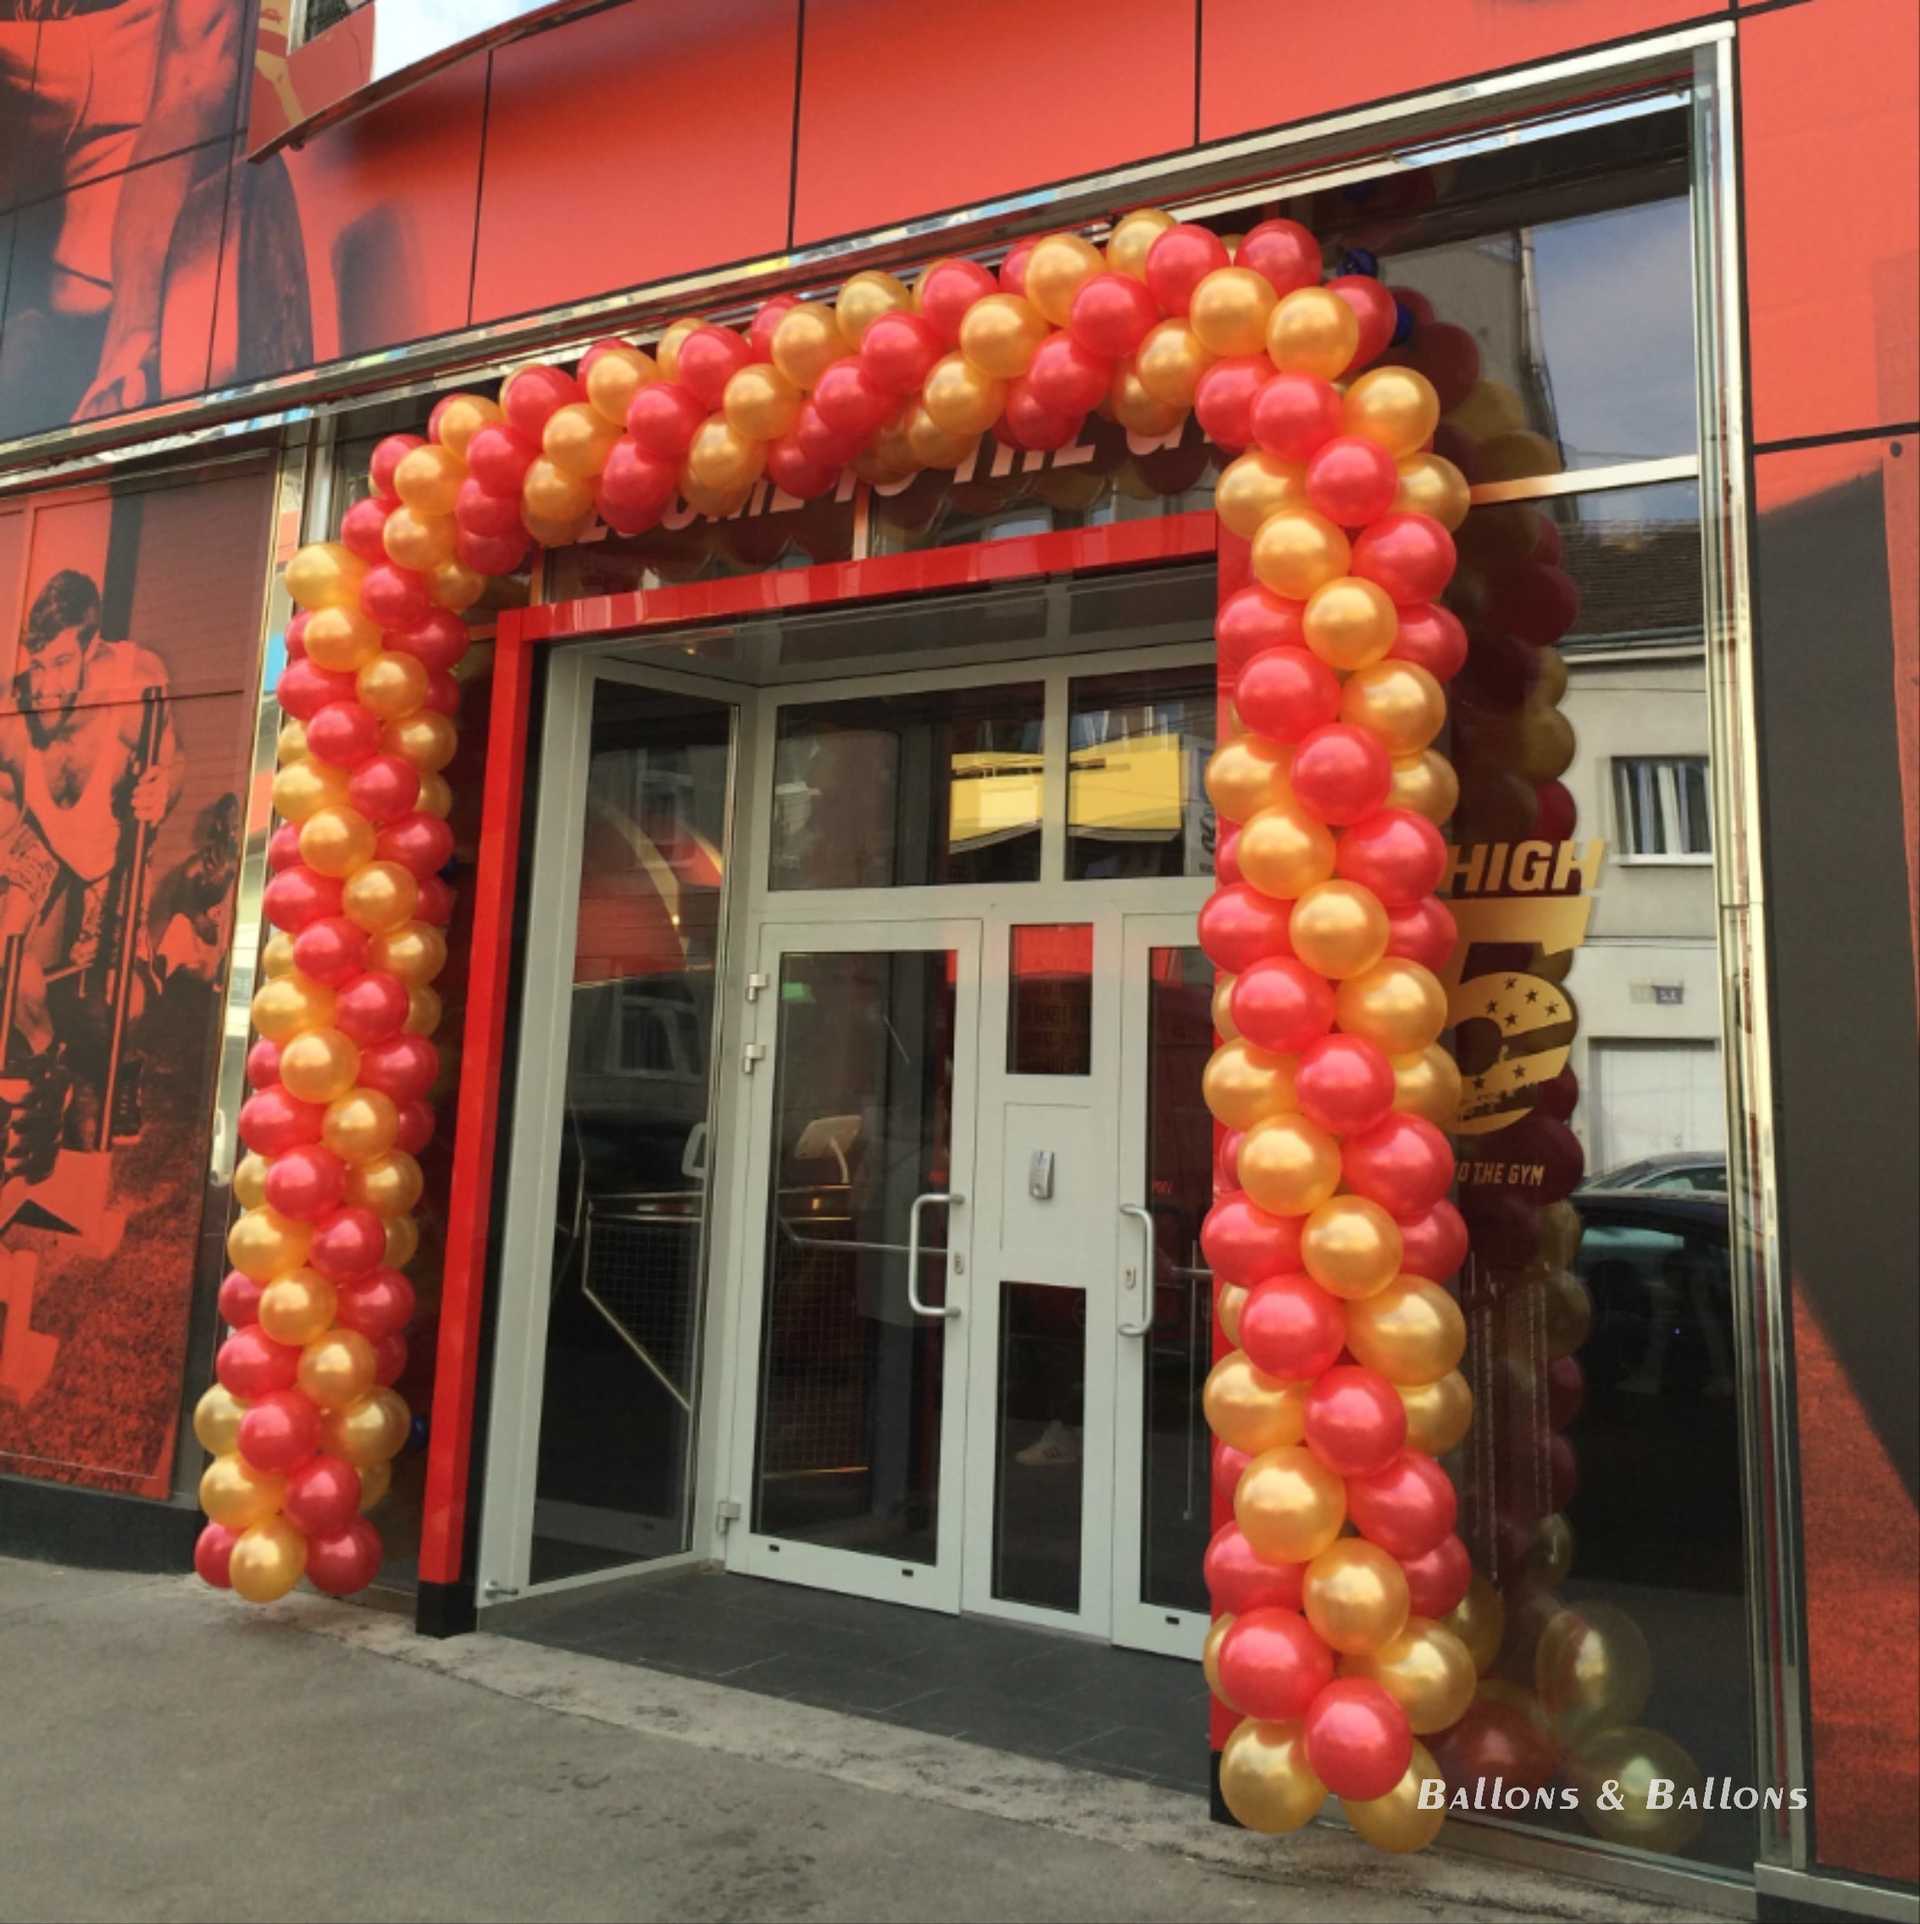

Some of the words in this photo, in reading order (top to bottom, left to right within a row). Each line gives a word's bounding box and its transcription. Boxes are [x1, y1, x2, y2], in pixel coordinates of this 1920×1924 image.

[1439, 839, 1606, 892] HIGH
[1454, 1161, 1470, 1182] O
[1472, 1162, 1504, 1184] THE
[1508, 1164, 1545, 1186] GYM
